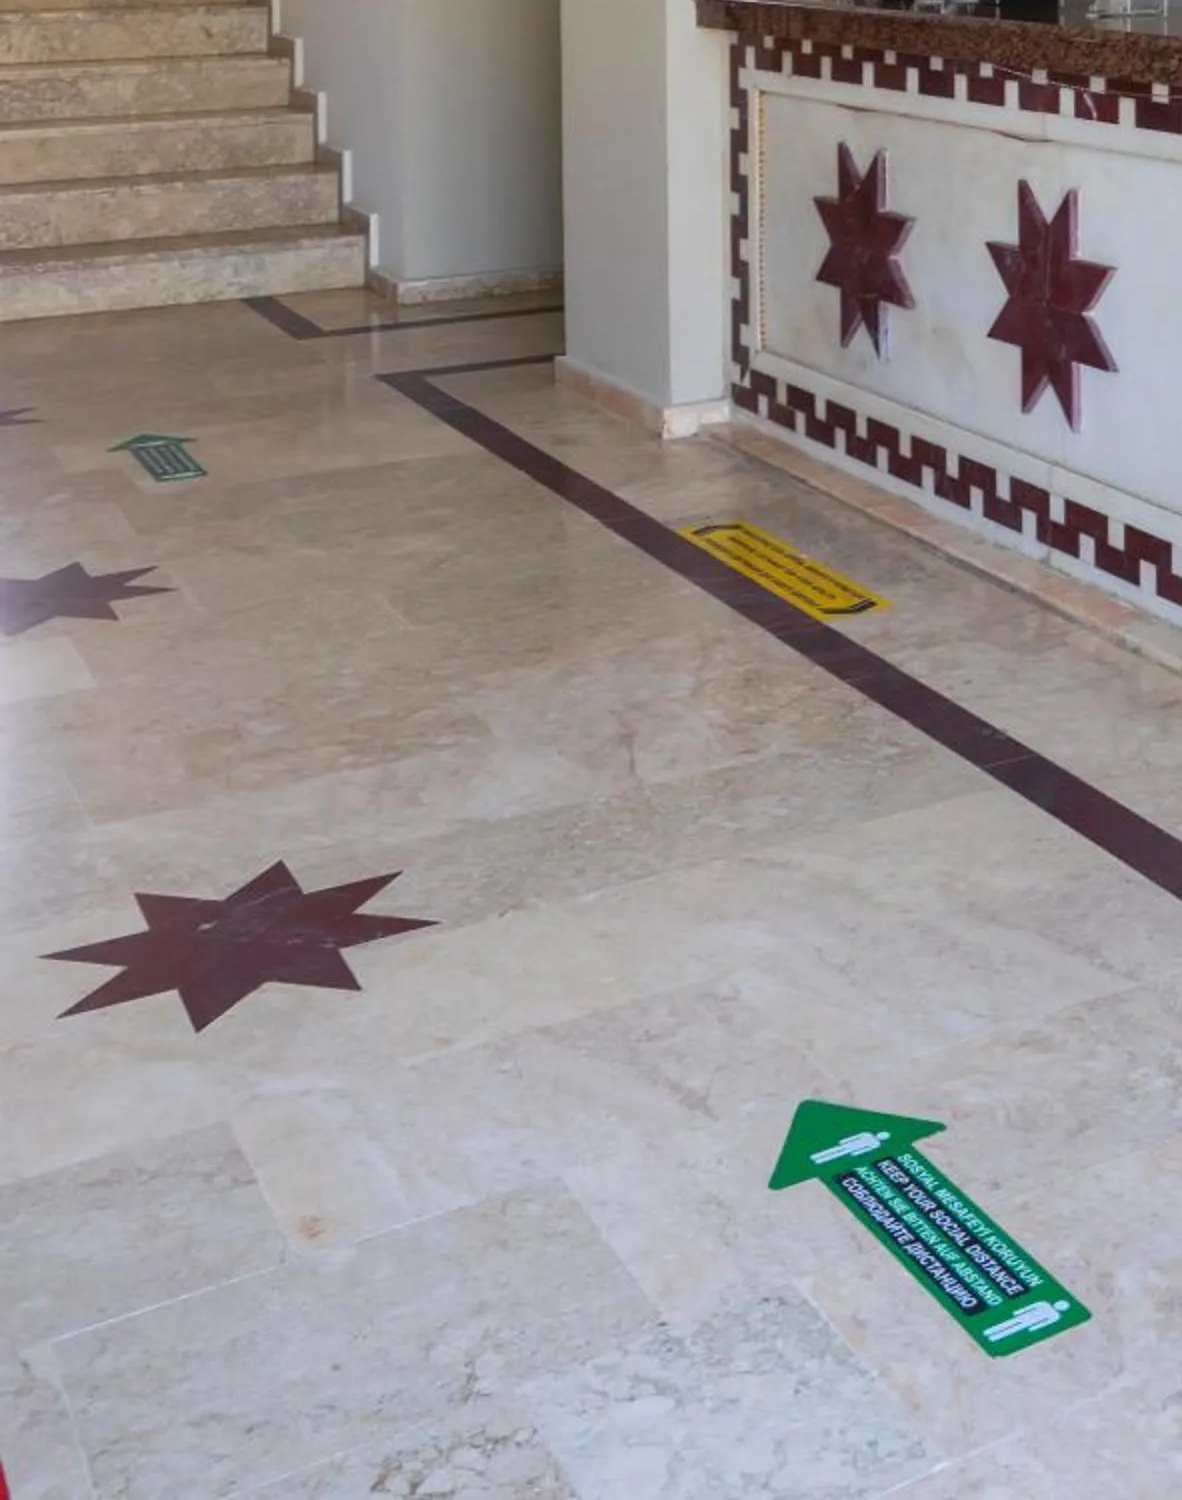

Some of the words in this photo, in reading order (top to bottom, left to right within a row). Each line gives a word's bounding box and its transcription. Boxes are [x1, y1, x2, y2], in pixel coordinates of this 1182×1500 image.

[877, 1160, 910, 1184] KEEP
[902, 1184, 937, 1212] YOUR
[929, 1209, 972, 1247] SOCIAL
[965, 1244, 1025, 1295] DISTANCE
[898, 1153, 940, 1191] SOSYAL
[984, 1235, 1043, 1286] KORUYUN
[933, 1243, 960, 1261] AUF
[951, 1261, 1003, 1306] ABSTAND
